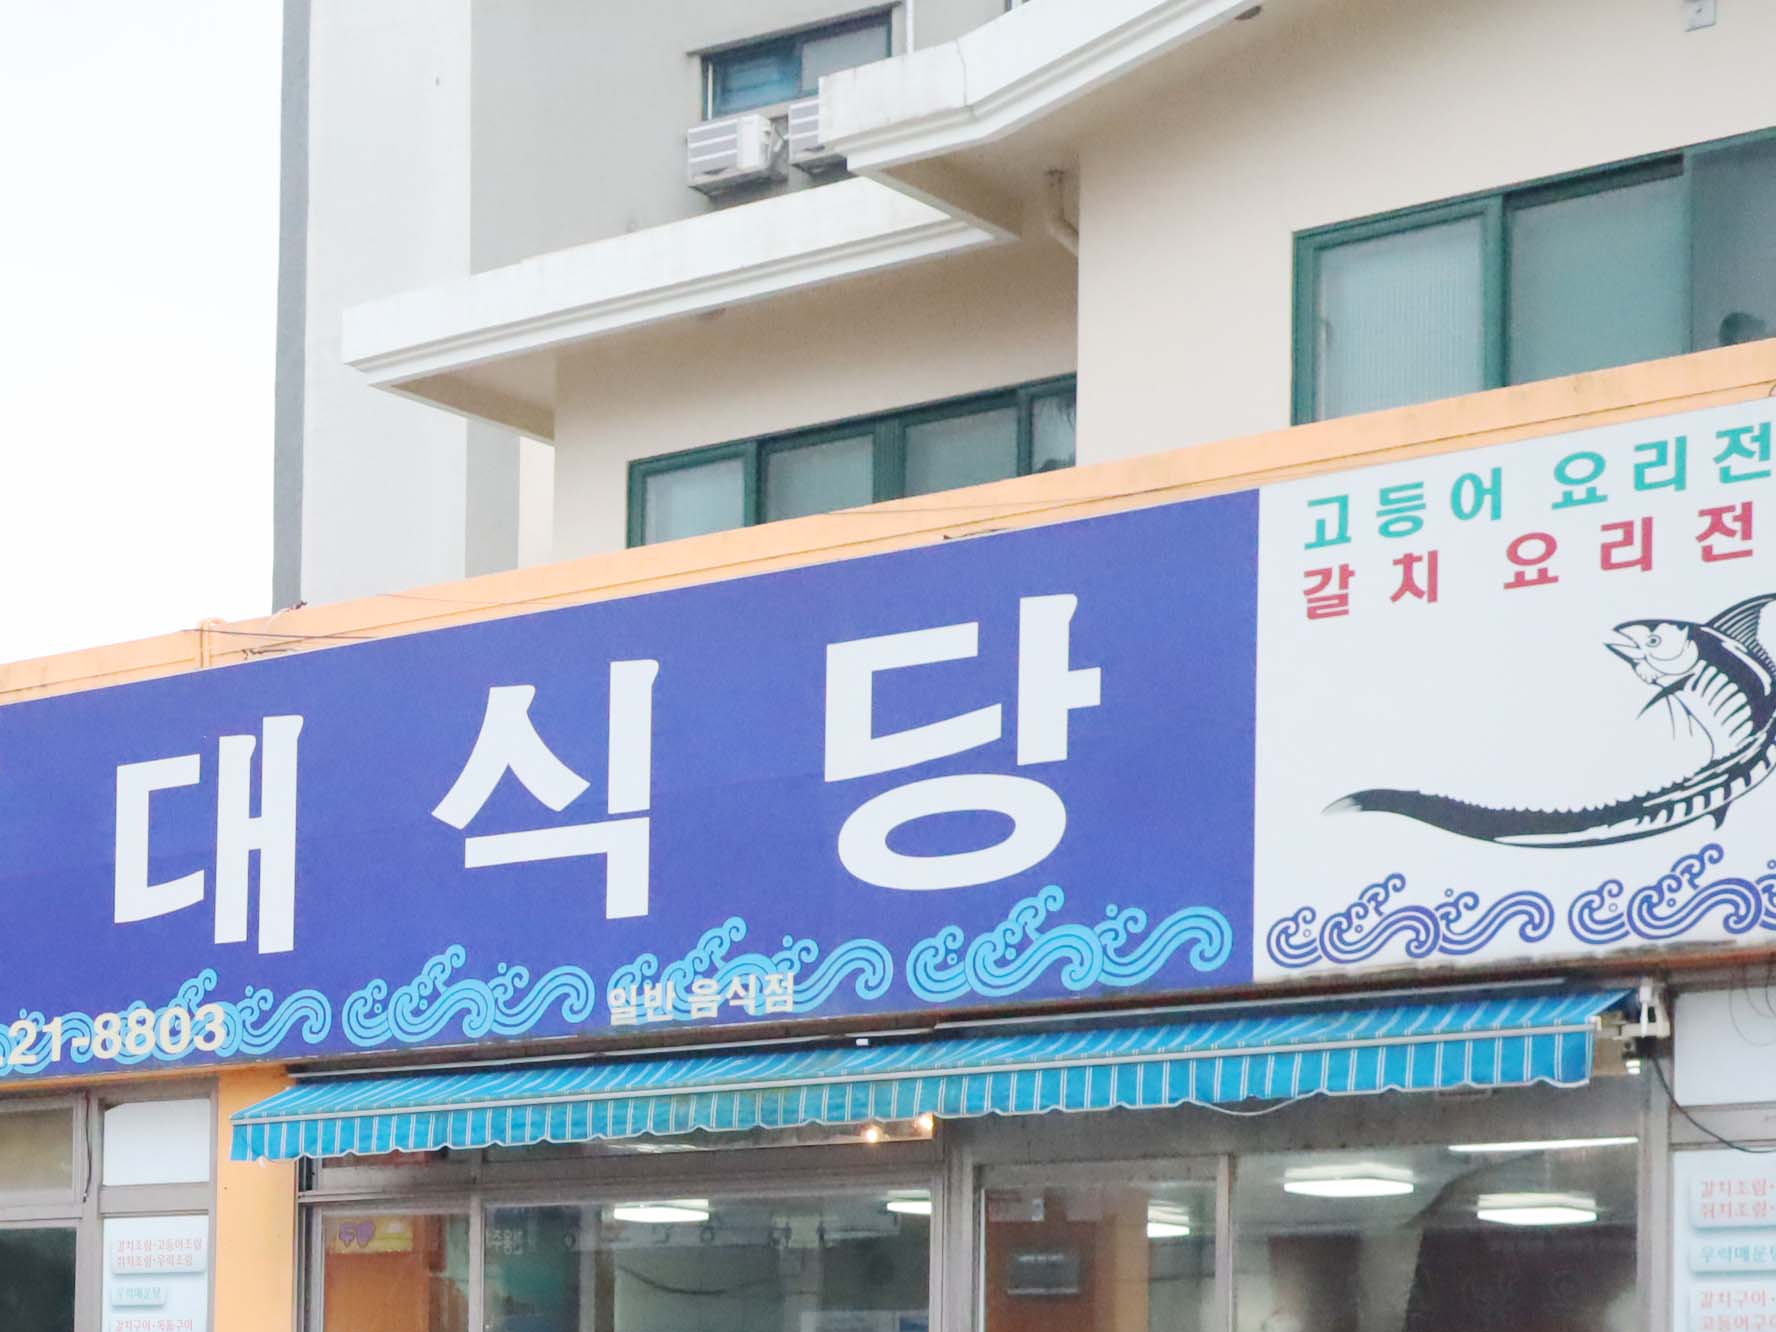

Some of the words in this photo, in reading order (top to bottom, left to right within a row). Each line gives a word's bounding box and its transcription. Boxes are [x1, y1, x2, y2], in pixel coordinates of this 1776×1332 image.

[1304, 467, 1503, 551] 고등어
[1550, 421, 1773, 511] 요리전
[1302, 549, 1440, 621] 갈치
[1502, 500, 1755, 591] 요리전
[608, 981, 676, 1027] 일반
[686, 971, 798, 1019] 음식점
